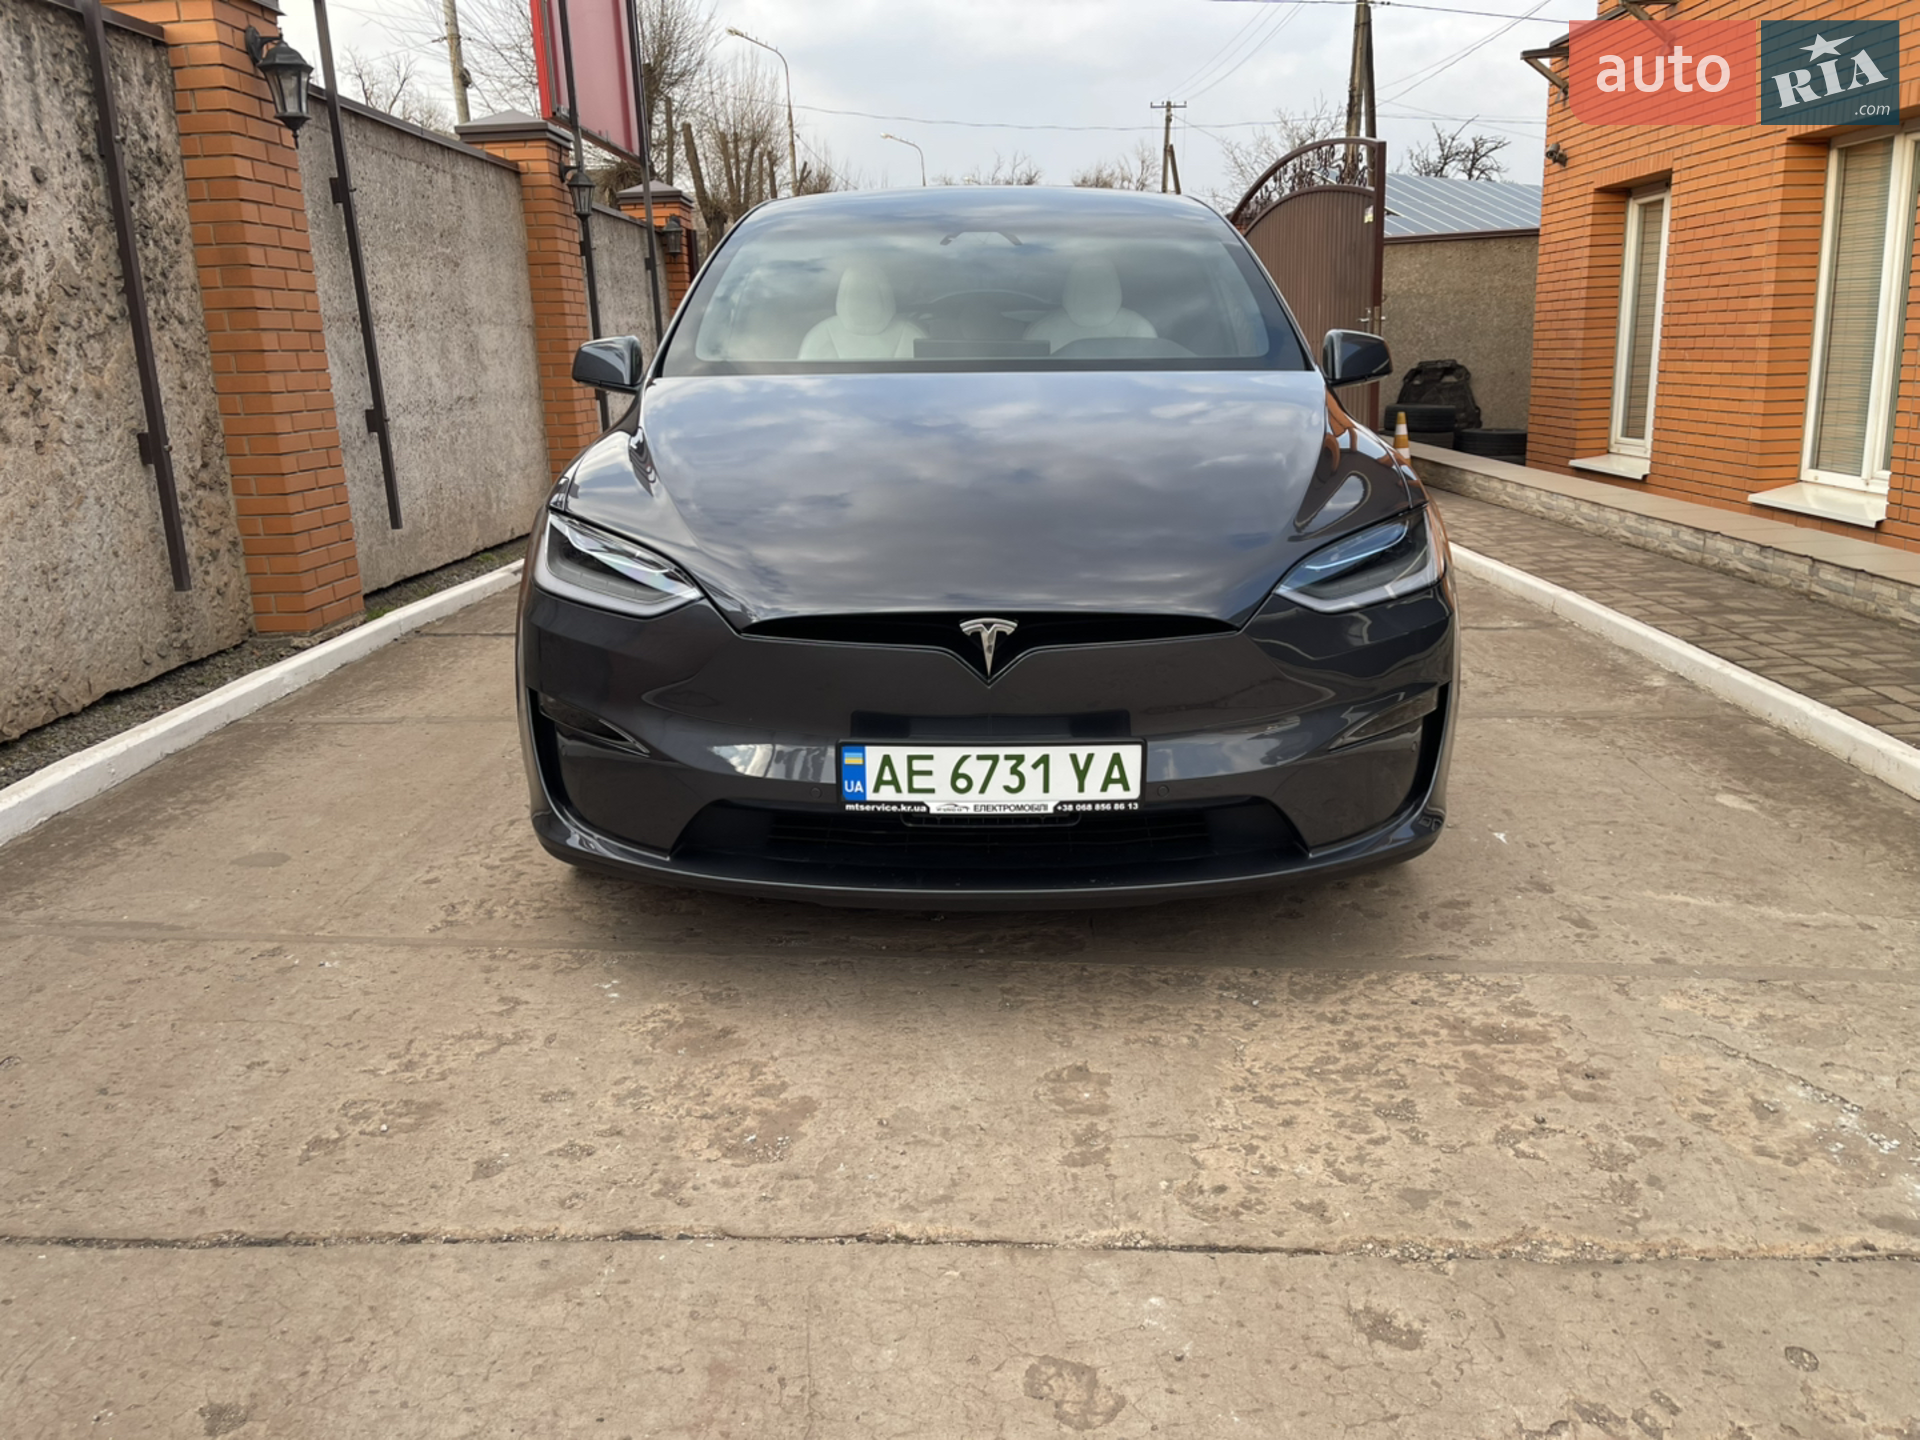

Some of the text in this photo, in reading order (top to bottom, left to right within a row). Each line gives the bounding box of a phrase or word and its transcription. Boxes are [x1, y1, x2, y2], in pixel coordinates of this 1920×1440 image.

[872, 752, 1131, 794] AE 6731 YA
[844, 780, 864, 793] UA
[845, 803, 927, 813] mtservice.kr.ua
[973, 803, 1049, 813] ЕЛЕКТРОМОБІЛІ
[1056, 803, 1074, 812] +38
[1127, 802, 1139, 810] 13
